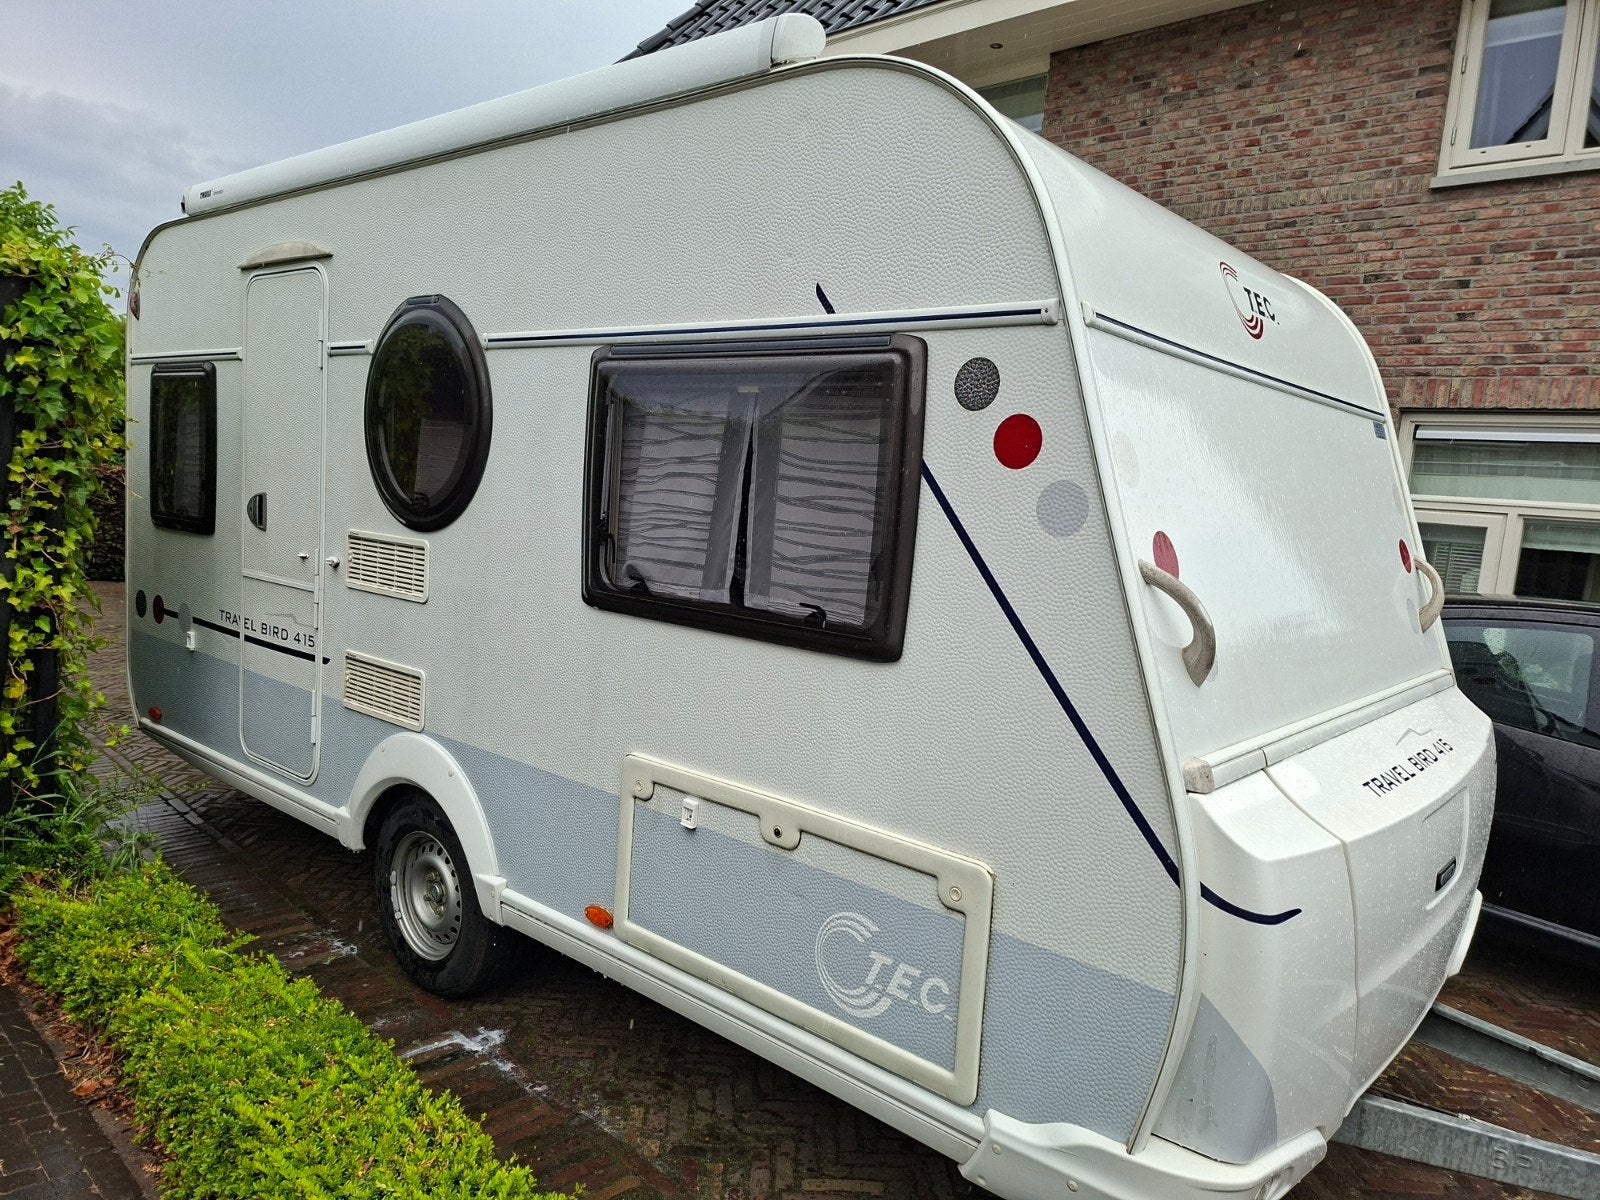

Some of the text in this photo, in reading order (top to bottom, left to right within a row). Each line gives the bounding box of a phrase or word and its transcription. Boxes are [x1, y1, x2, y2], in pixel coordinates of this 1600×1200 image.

[261, 622, 289, 641] BIRD
[293, 632, 315, 648] 415
[1362, 738, 1454, 797] TRAVEL BIRD 415
